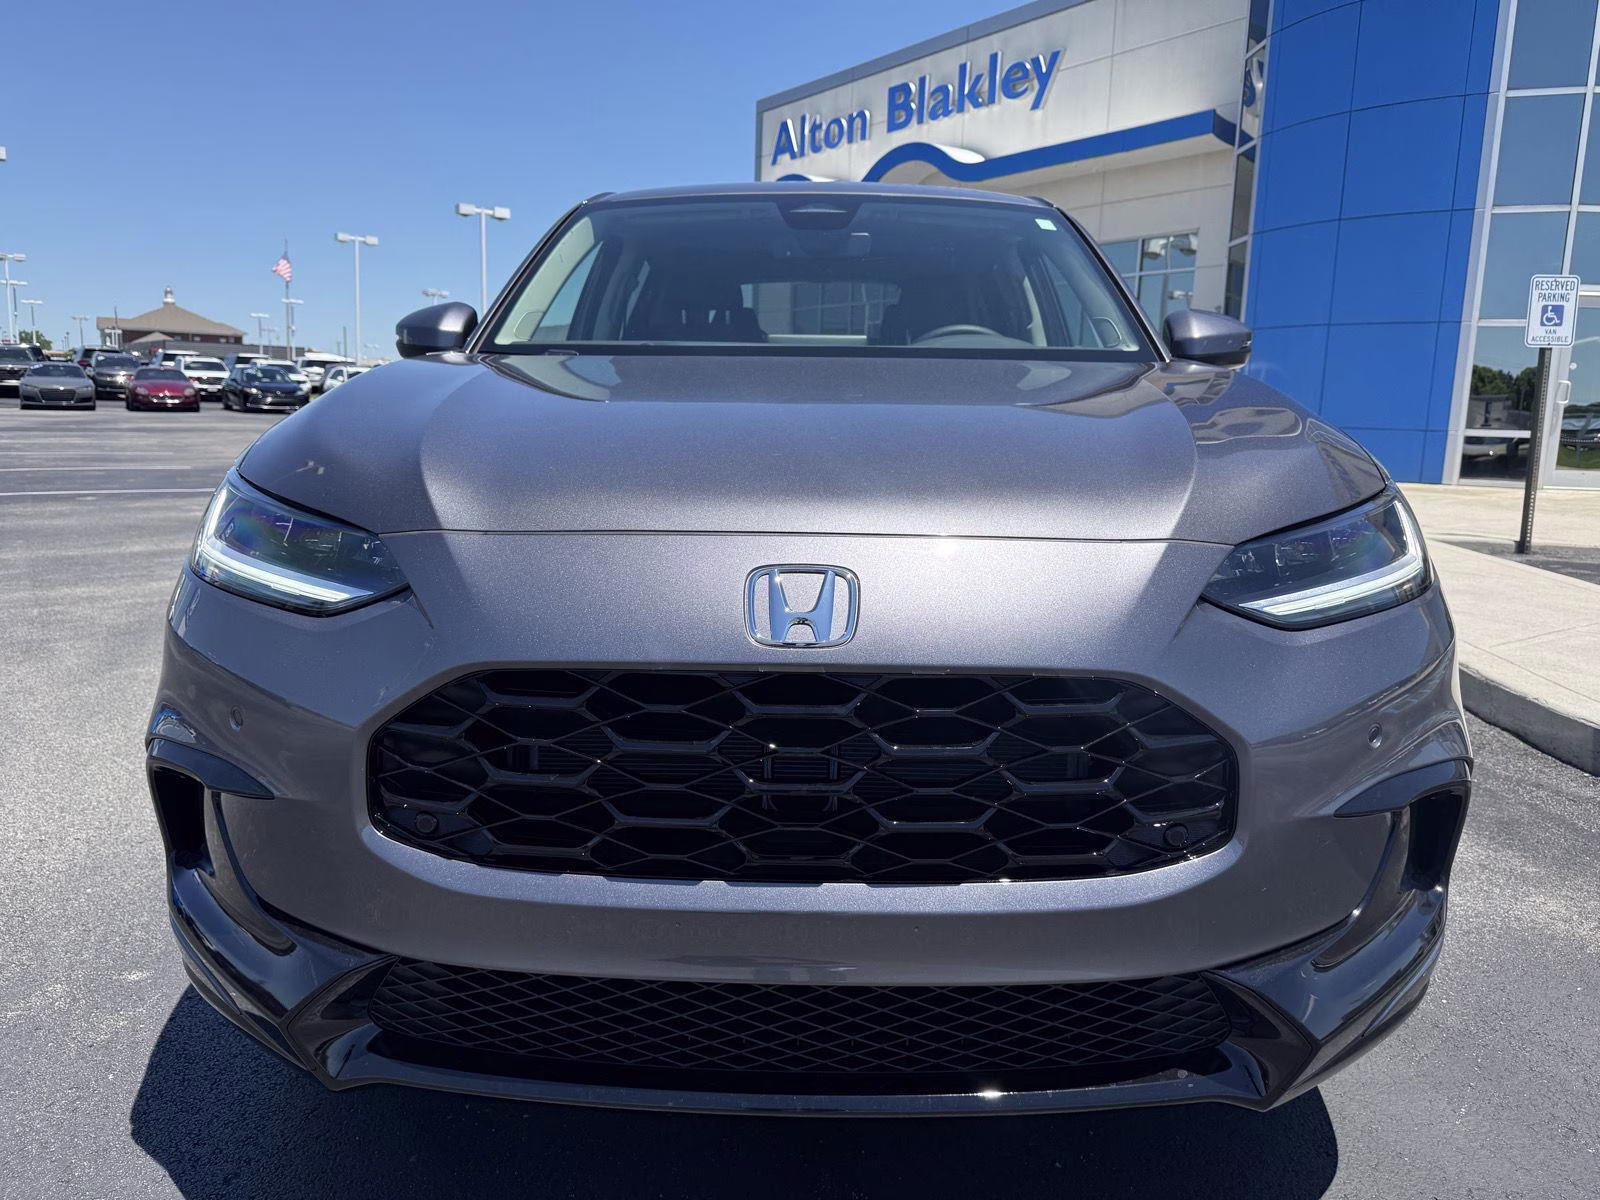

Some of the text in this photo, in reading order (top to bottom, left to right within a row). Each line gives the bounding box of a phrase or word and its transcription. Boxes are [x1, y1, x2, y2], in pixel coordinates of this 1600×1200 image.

[771, 49, 1062, 166] Alton Blakley
[1535, 280, 1575, 291] RESERVED
[1538, 292, 1570, 302] PARKING
